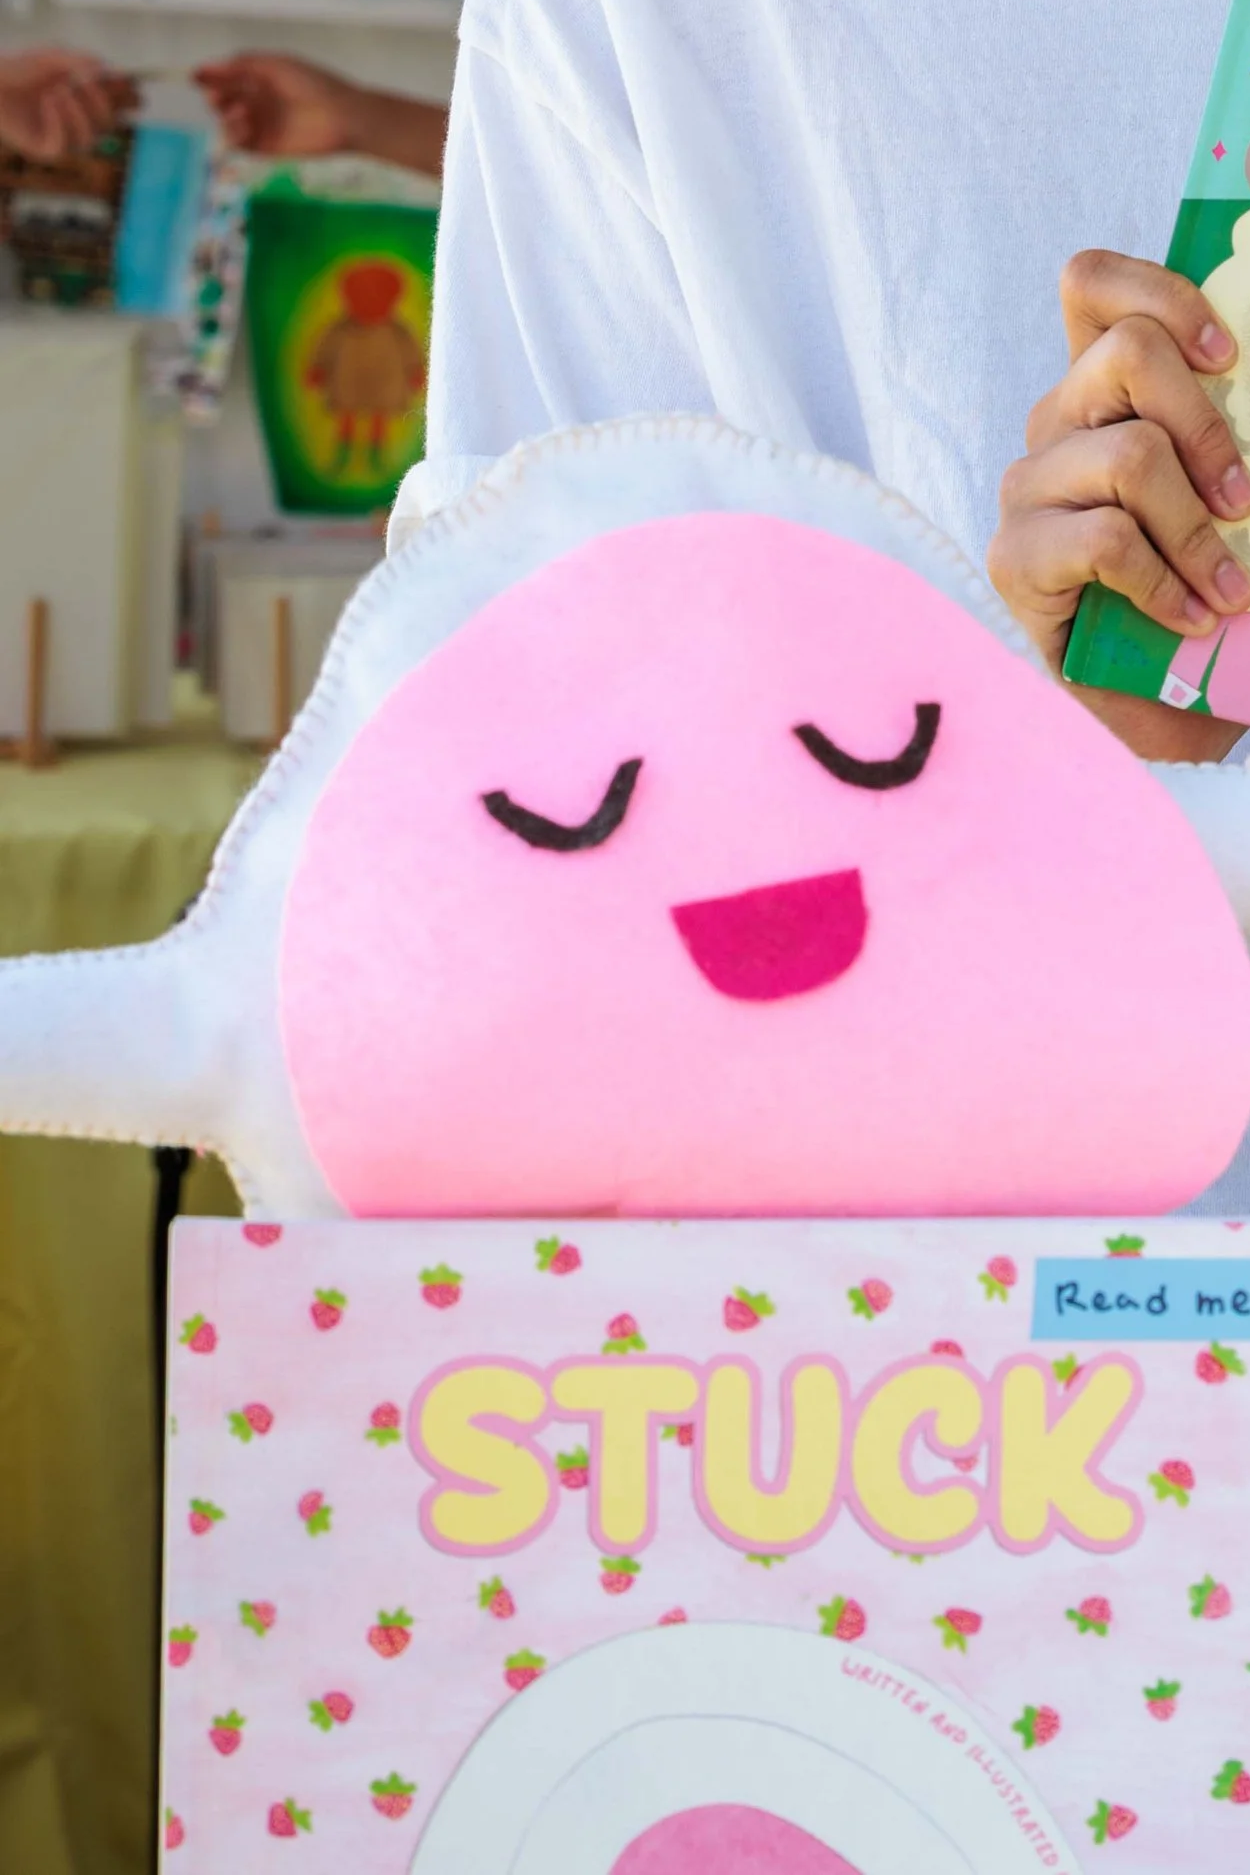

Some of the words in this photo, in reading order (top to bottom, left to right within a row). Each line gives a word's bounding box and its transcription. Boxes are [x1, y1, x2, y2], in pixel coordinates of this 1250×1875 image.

[1056, 1280, 1168, 1317] Read
[407, 1352, 1145, 1557] STUCK
[841, 1655, 931, 1715] WRITTEN
[930, 1712, 968, 1745] AND
[964, 1743, 1060, 1868] ILLUSTRATED
